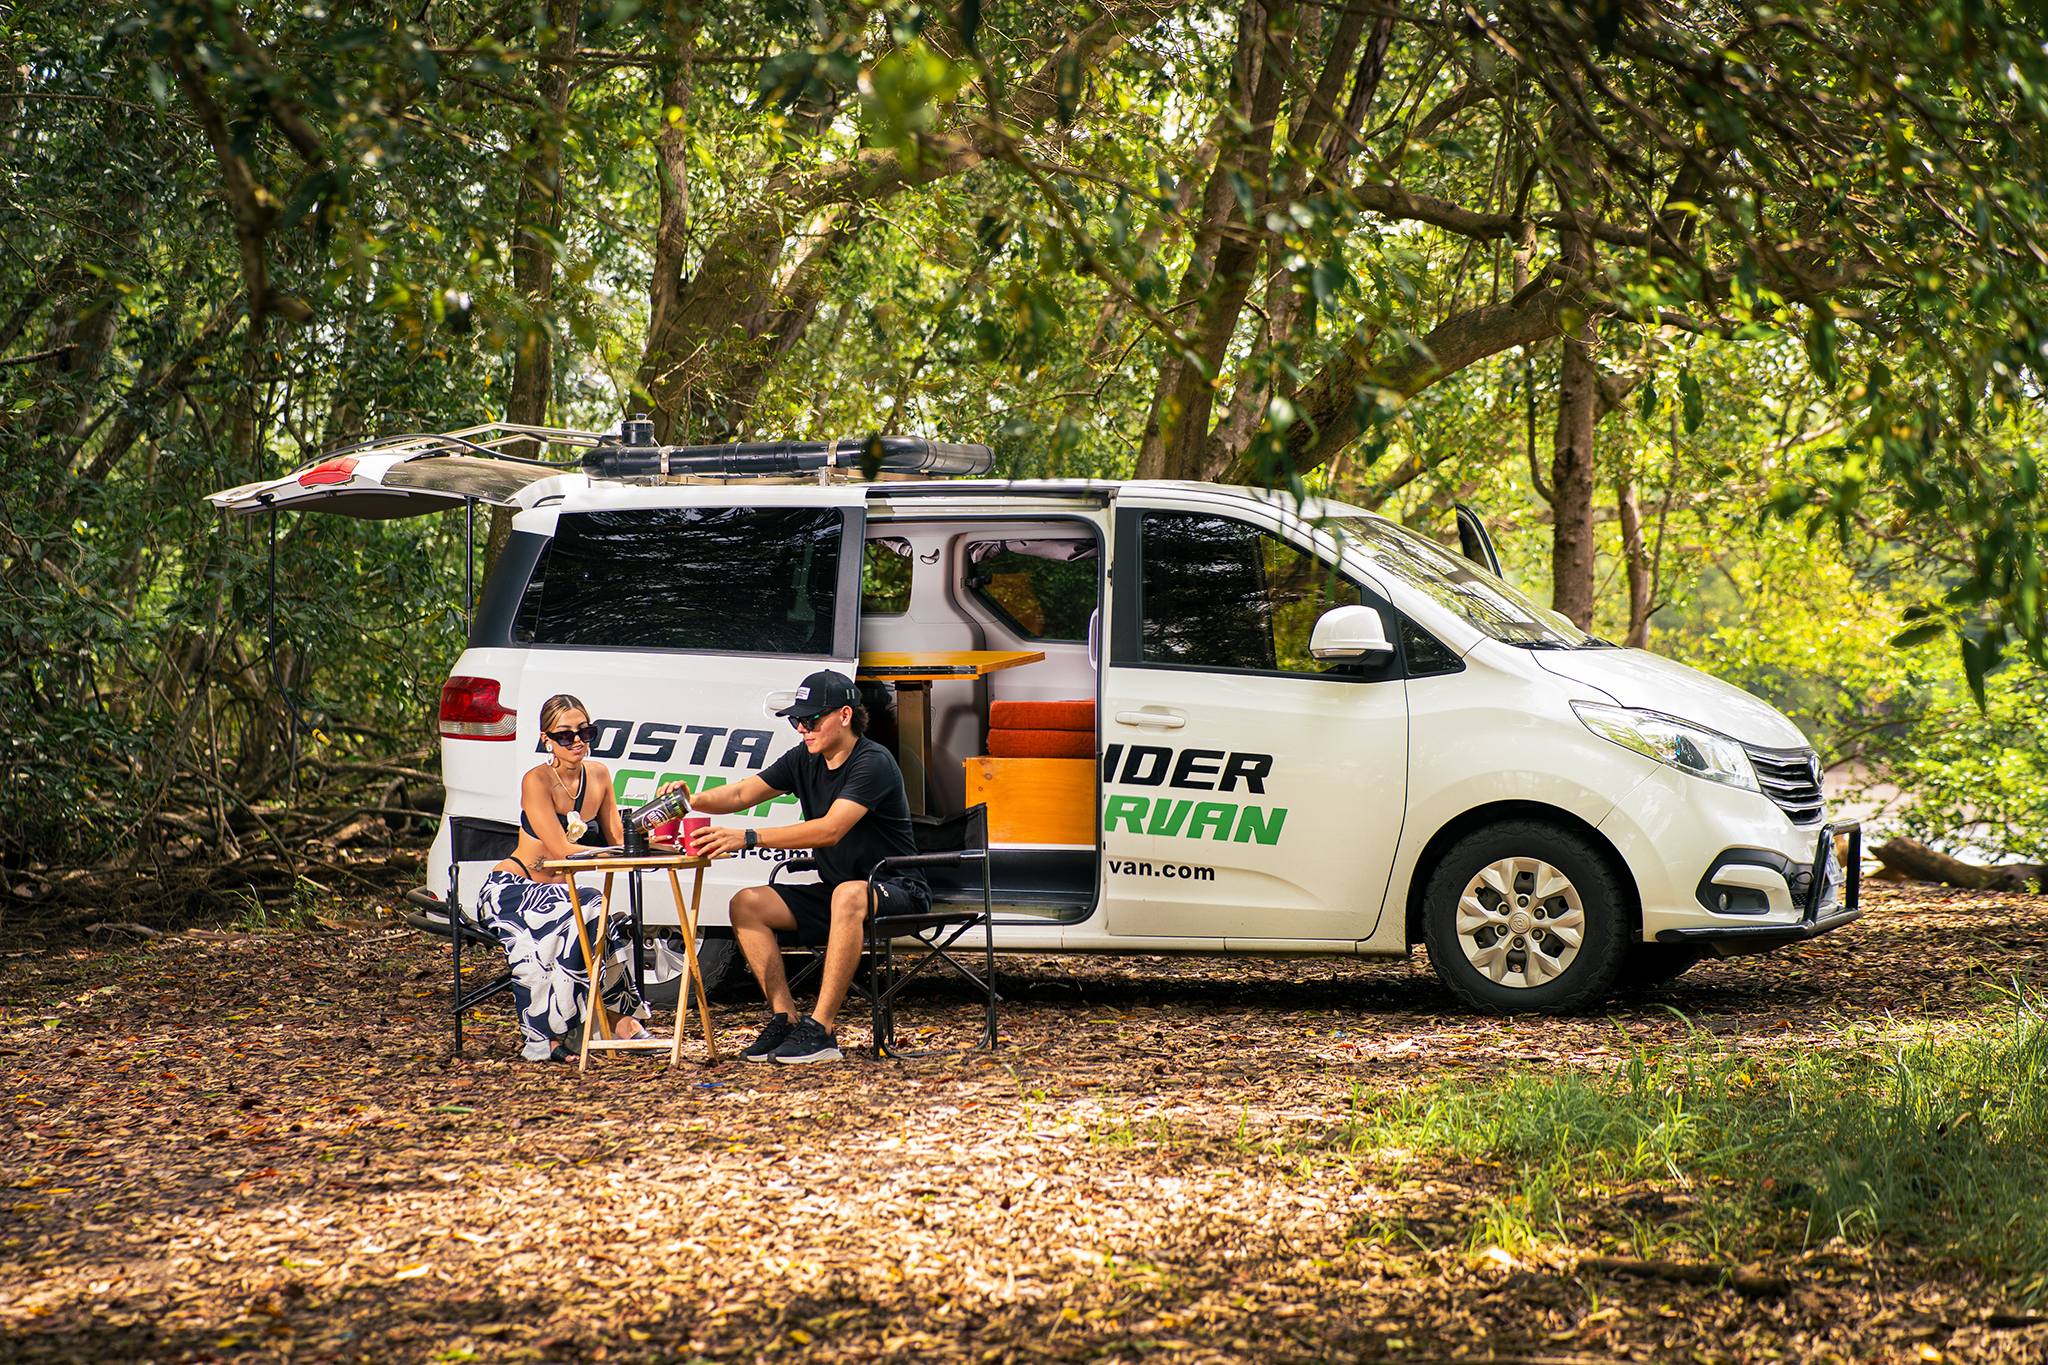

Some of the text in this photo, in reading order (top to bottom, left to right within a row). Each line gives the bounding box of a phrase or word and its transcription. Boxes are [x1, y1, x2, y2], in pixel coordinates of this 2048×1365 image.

[535, 719, 774, 769] OSTA
[1104, 794, 1288, 845] RVAN
[1108, 860, 1215, 881] van.com
